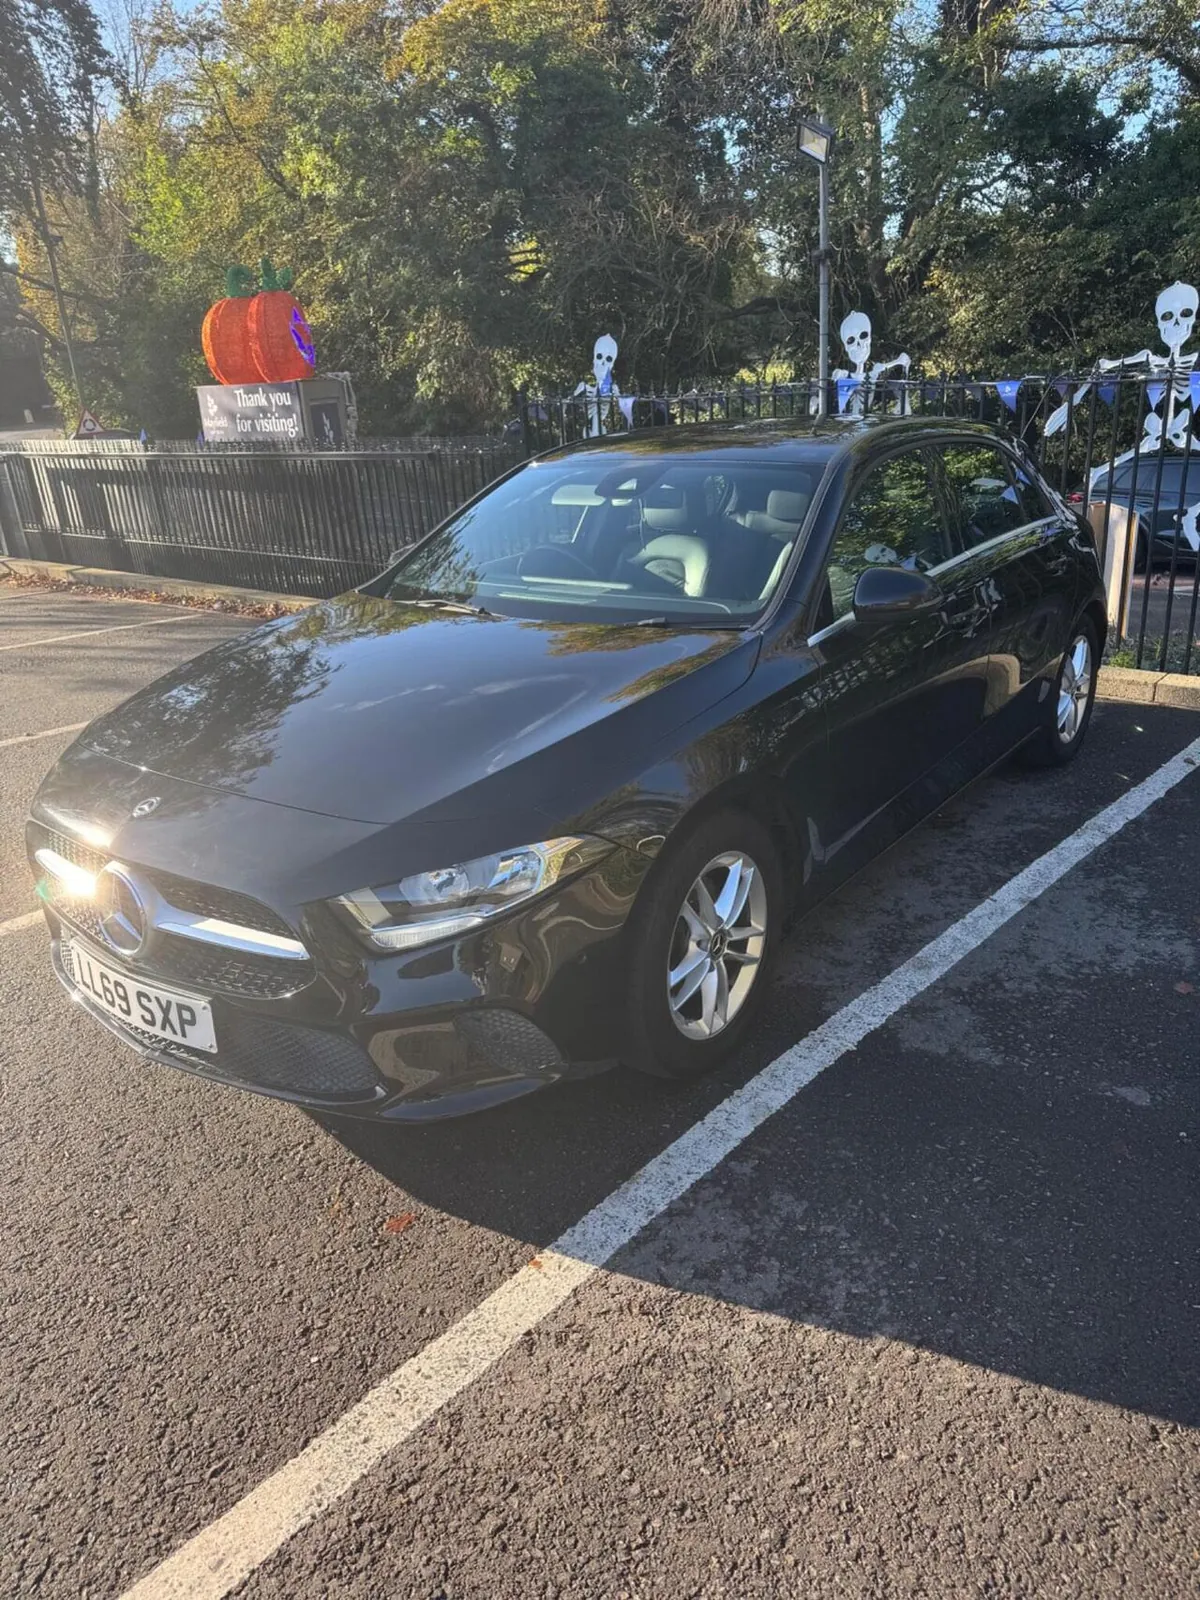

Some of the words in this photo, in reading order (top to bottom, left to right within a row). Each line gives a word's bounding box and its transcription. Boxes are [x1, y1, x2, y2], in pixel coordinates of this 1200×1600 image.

[234, 388, 267, 408] Thank
[269, 391, 291, 411] you
[236, 414, 251, 432] for
[254, 414, 299, 438] visiting!
[76, 952, 131, 1017] LL69
[136, 990, 197, 1039] SXP
